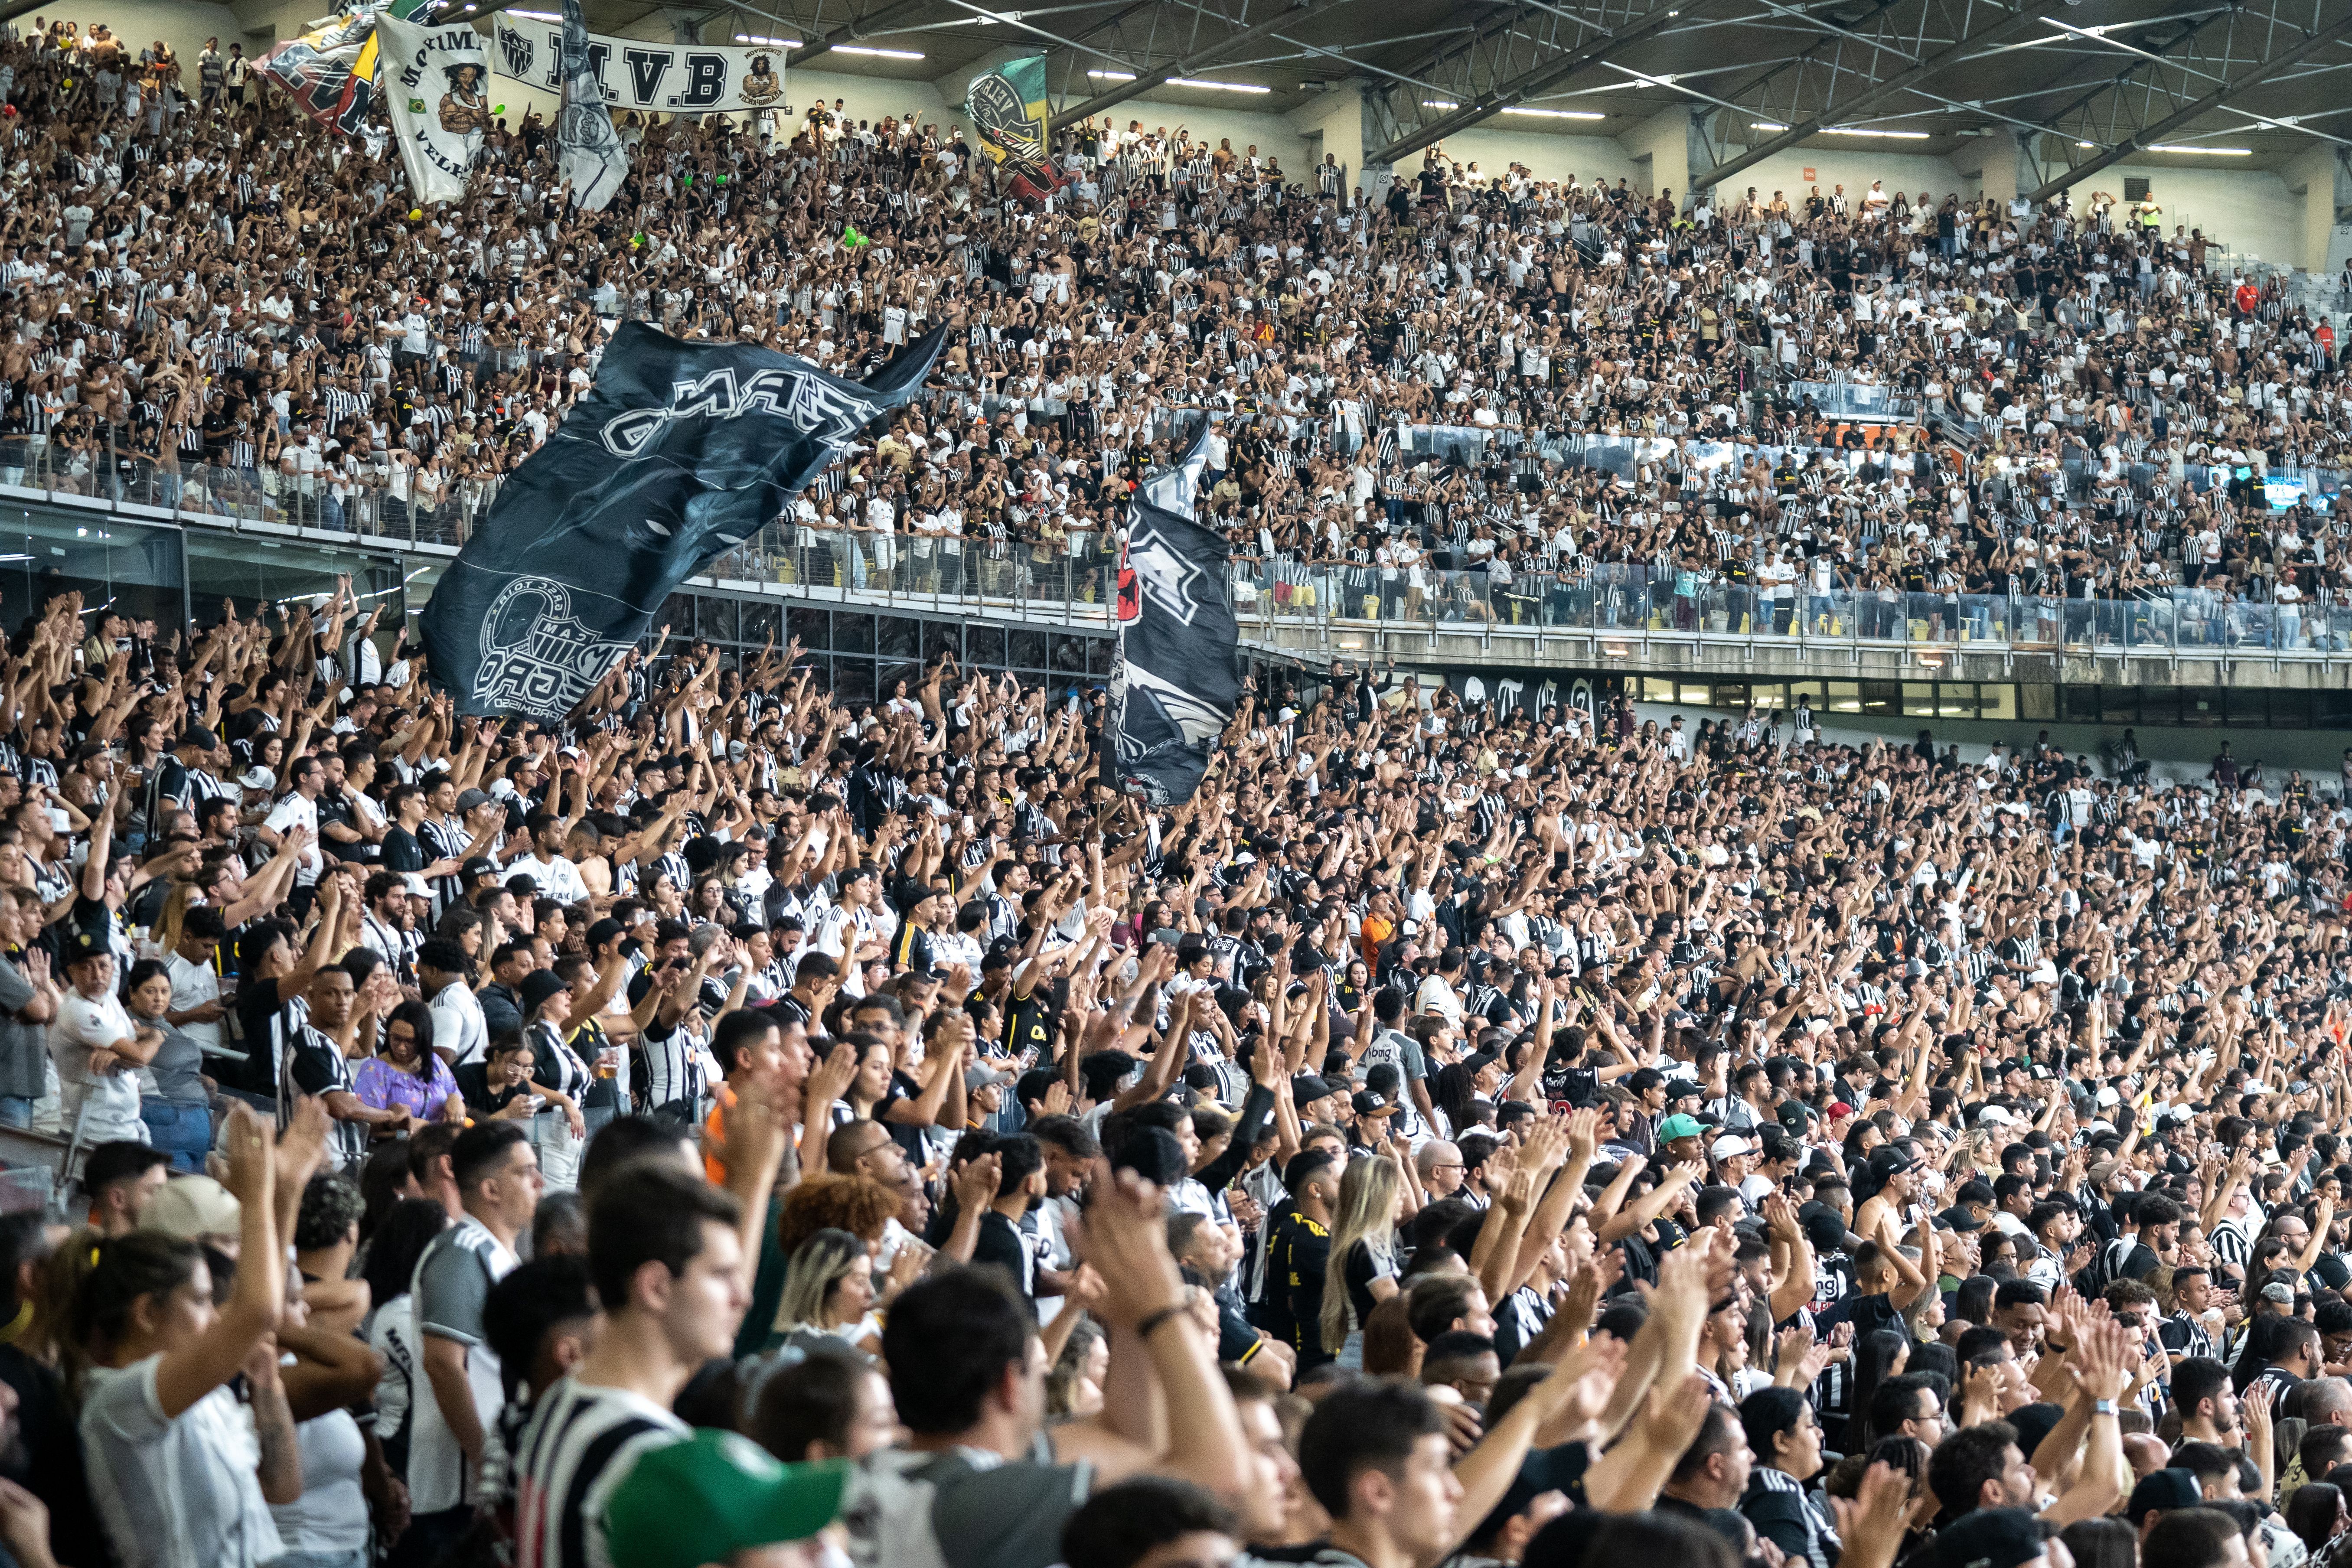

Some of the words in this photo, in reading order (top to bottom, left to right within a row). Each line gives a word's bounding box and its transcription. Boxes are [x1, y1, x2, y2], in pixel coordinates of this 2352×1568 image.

[1283, 879, 1294, 893] MRV
[1217, 939, 1232, 951] bmg
[1371, 1047, 1392, 1063] bmg
